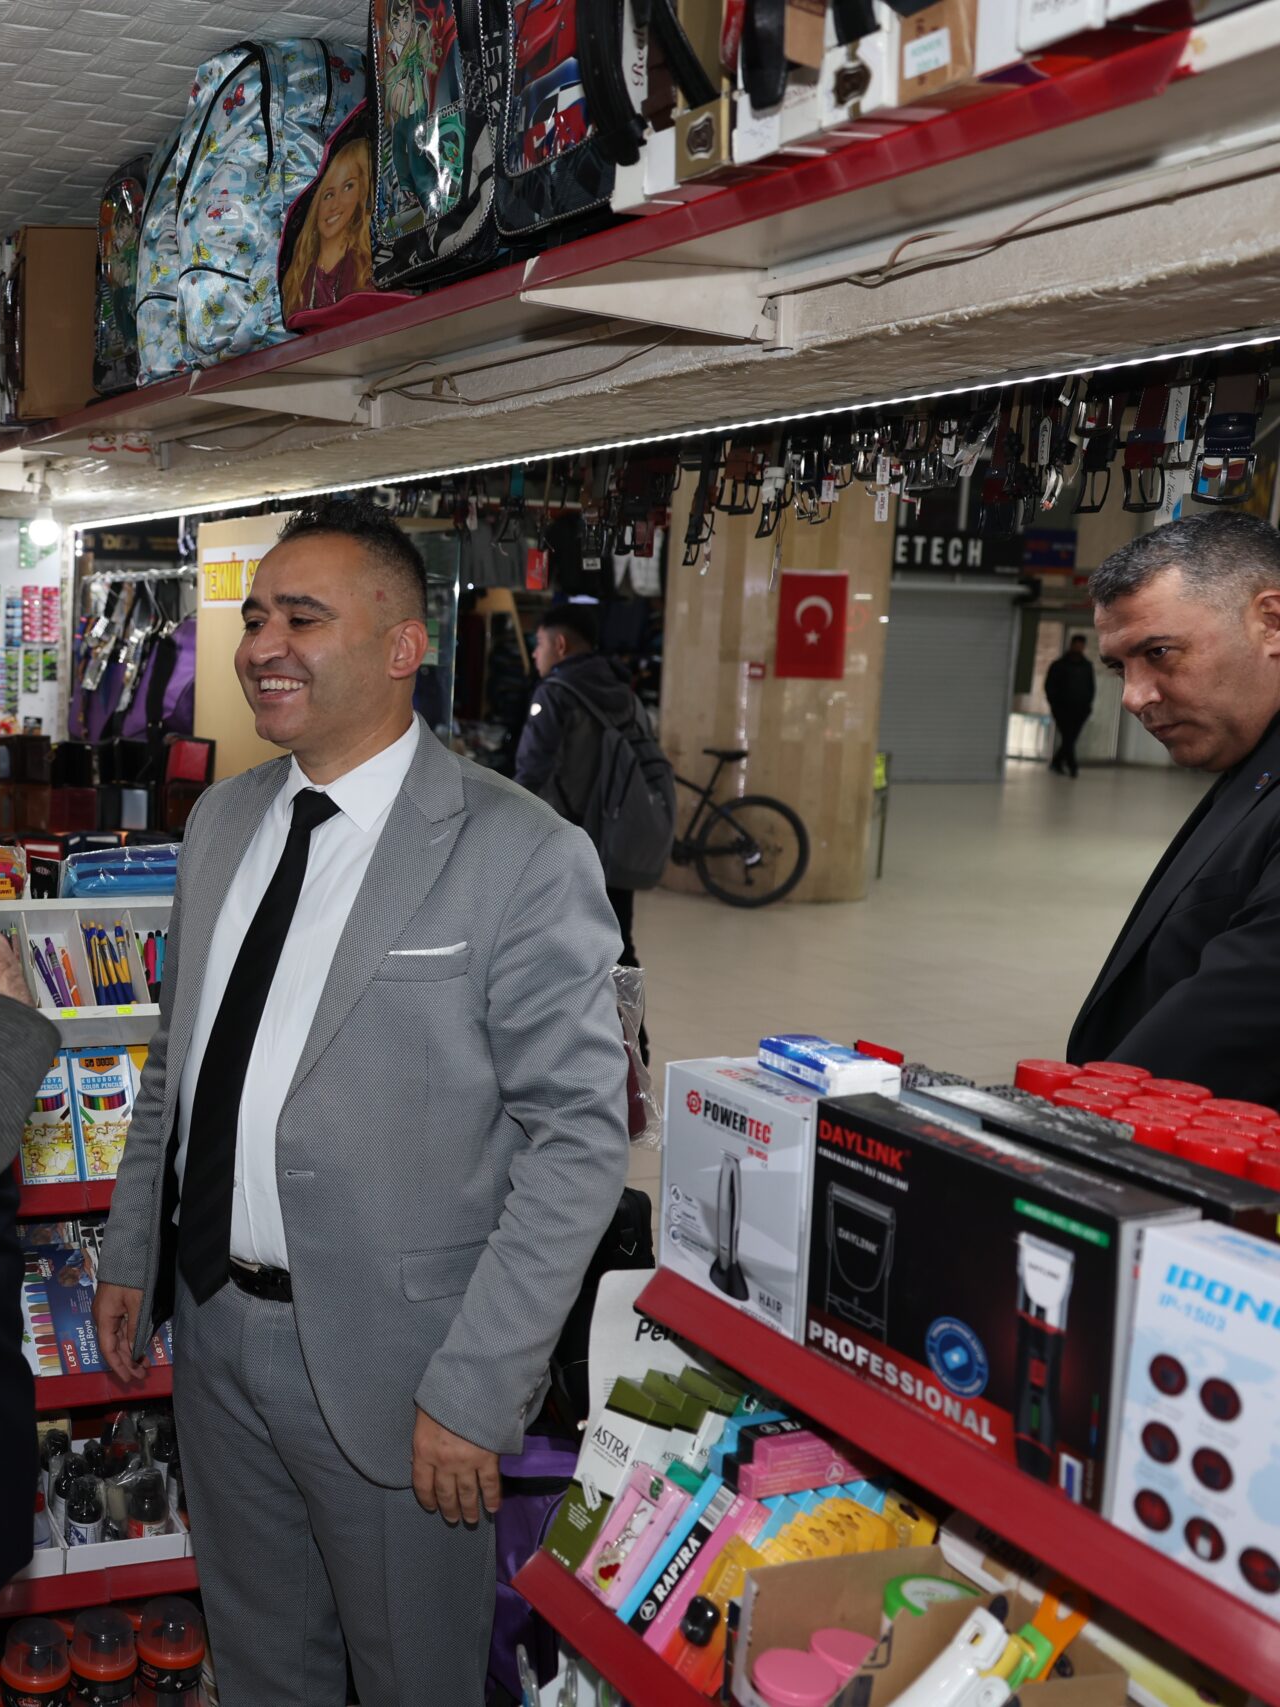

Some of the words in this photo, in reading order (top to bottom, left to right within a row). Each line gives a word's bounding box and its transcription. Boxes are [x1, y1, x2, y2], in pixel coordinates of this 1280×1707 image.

[894, 535, 984, 568] ETECH
[703, 1099, 772, 1145] POWERTEC
[819, 1119, 904, 1172] DAYLINK
[836, 1226, 879, 1255] DAYLINK
[757, 1290, 783, 1314] HAIR
[76, 1326, 87, 1352] Pastel
[84, 1319, 95, 1338] Boya
[80, 1352, 91, 1365] Oil
[87, 1338, 100, 1365] Pastel
[808, 1319, 998, 1445] PROFESSIONAL
[592, 1424, 632, 1464] ASTRA
[652, 1534, 703, 1603] RAPIRA
